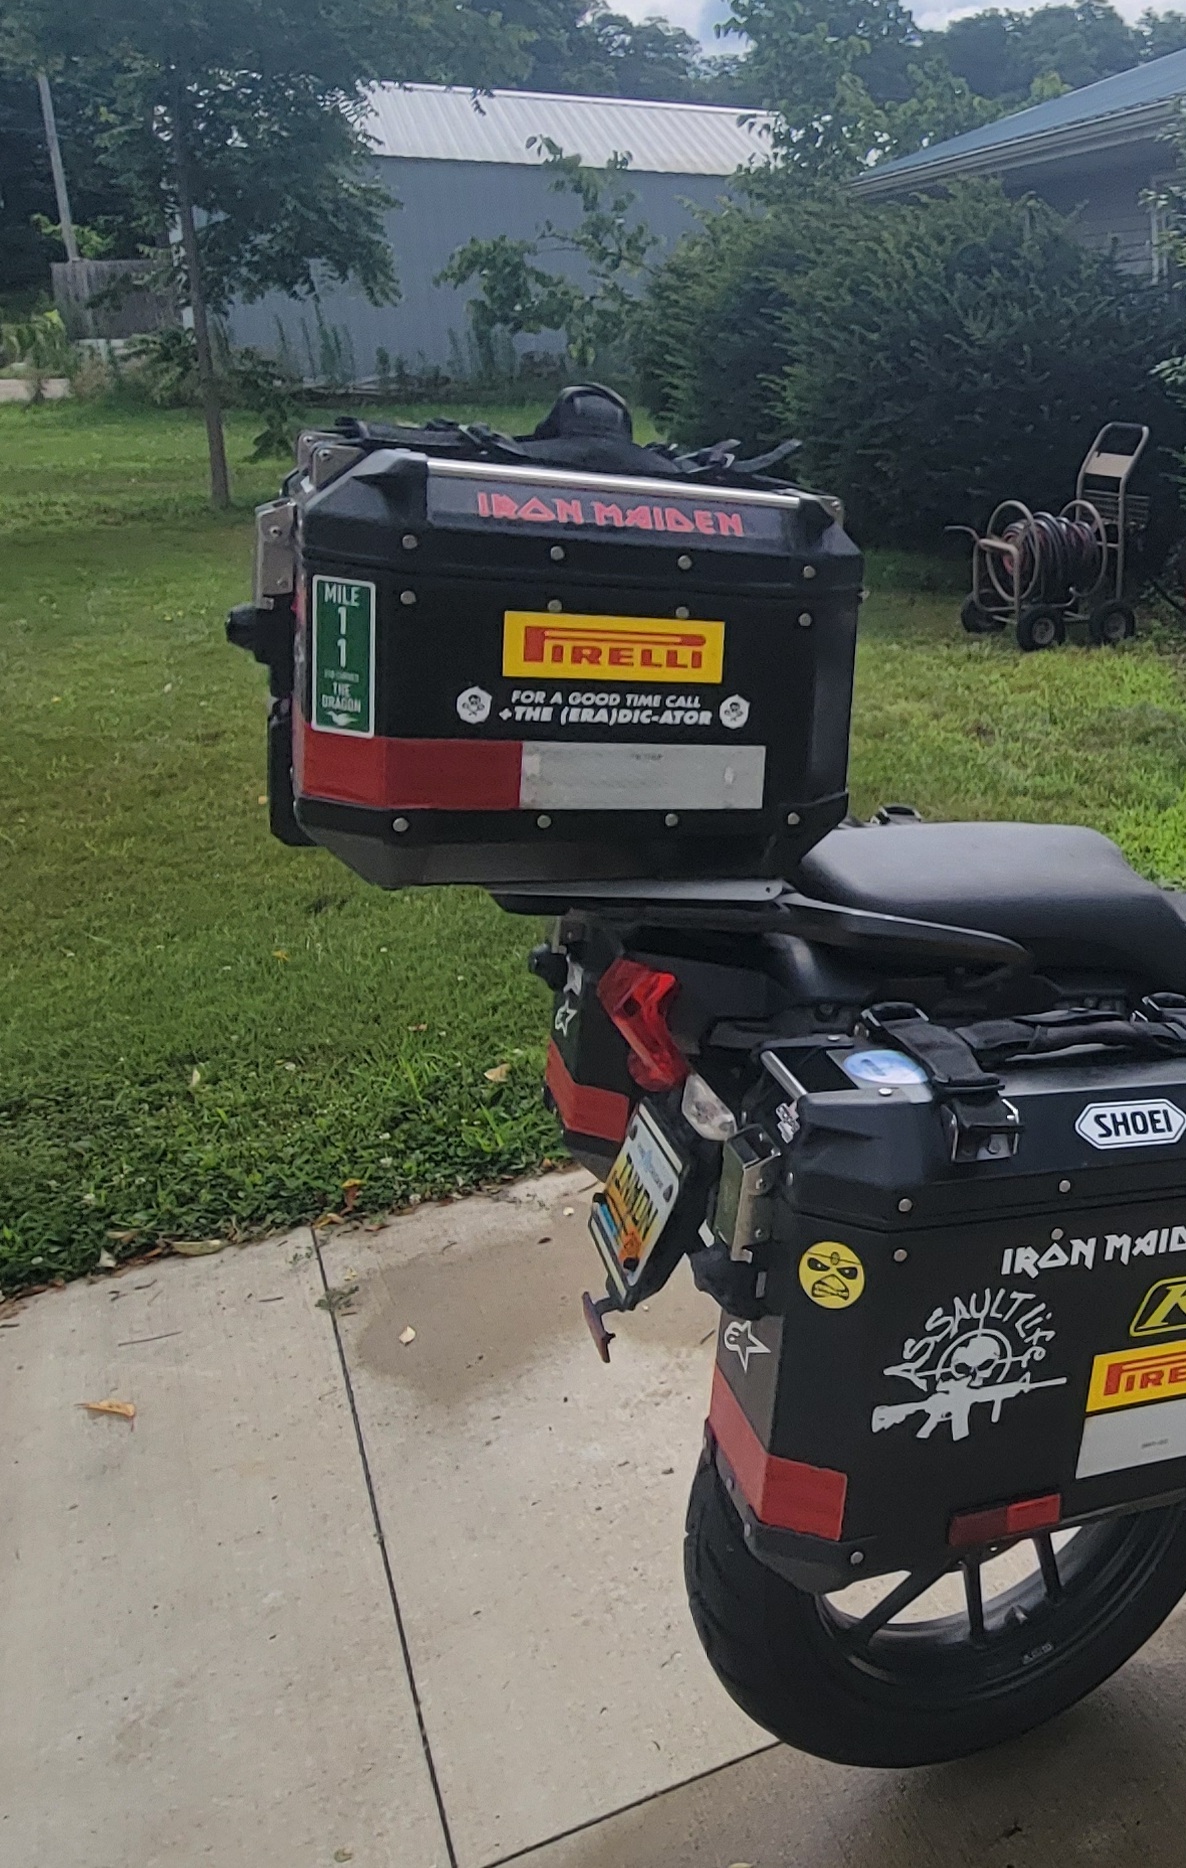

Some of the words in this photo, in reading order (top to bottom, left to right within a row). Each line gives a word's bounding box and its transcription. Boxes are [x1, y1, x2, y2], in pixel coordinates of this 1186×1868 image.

[477, 492, 584, 524] IRON
[593, 501, 745, 537] MAIDEN
[324, 583, 360, 607] MILE
[523, 626, 706, 669] PIRELLI
[321, 694, 361, 713] DRAGON
[511, 690, 546, 704] FOR
[549, 691, 563, 705] A
[568, 691, 620, 706] GOOD
[625, 693, 662, 708] TIME
[665, 694, 701, 709] CALL
[1093, 1109, 1173, 1138] SHOEI
[1000, 1237, 1097, 1279] IRON
